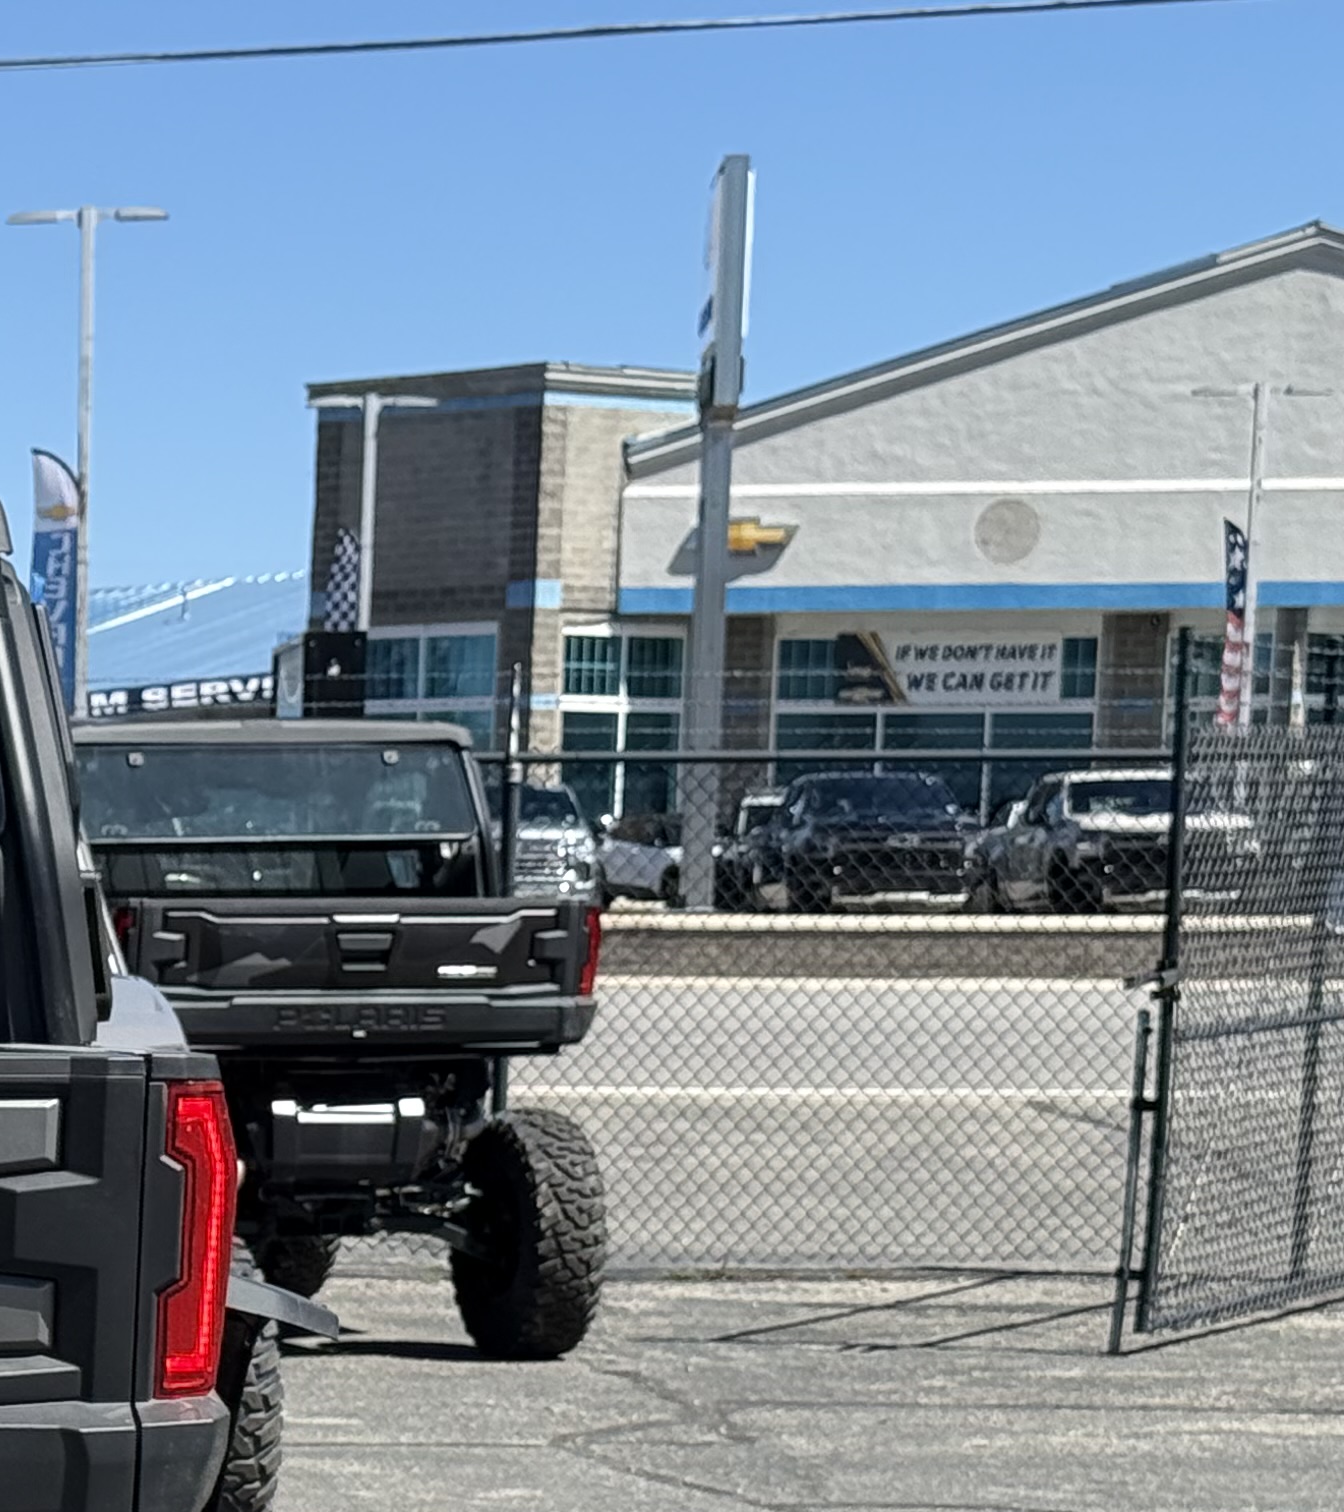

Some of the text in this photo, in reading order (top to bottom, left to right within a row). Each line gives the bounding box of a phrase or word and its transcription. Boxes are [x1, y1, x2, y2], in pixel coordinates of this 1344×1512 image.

[895, 643, 1057, 662] IF WE DON'T HAVE IT
[906, 671, 1055, 692] WE CAN GET IT
